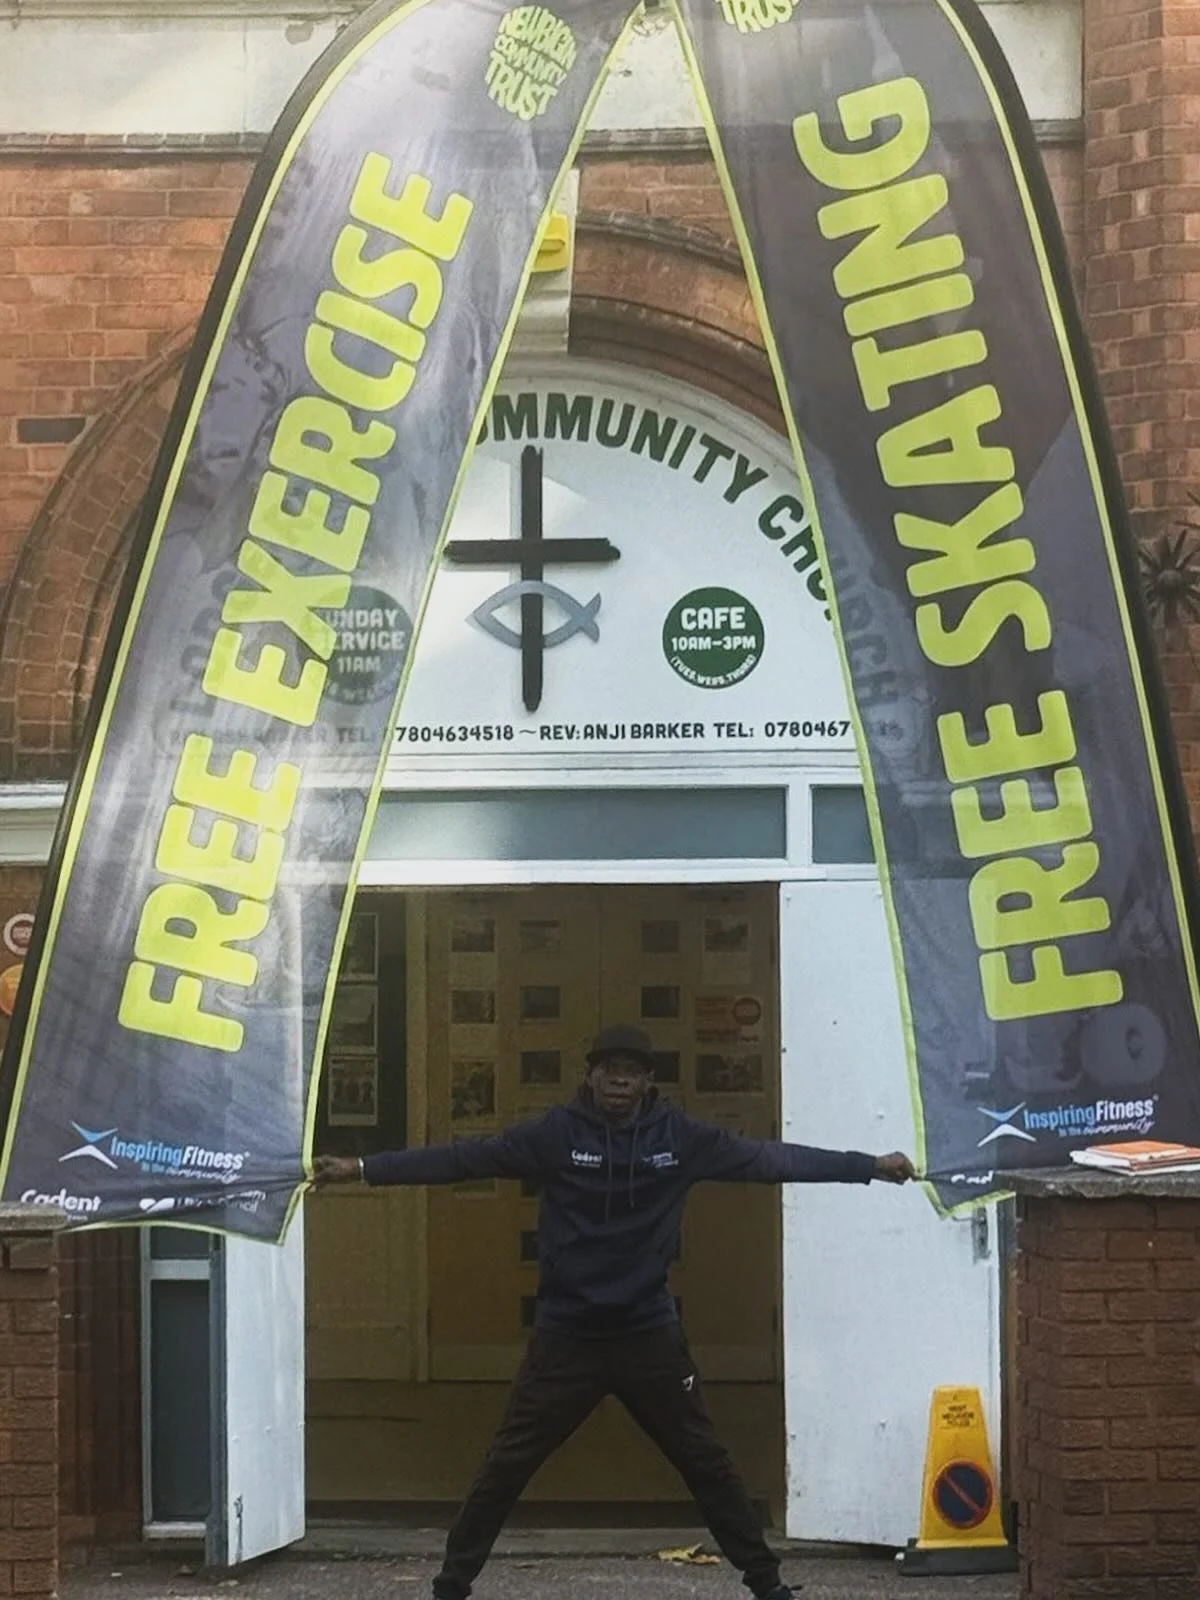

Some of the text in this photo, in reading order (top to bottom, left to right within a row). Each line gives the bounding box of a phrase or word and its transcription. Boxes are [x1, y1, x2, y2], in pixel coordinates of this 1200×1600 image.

[484, 50, 558, 120] TRUST
[494, 34, 568, 87] COMMUNITY
[203, 152, 474, 726] EXERCISE
[793, 76, 1123, 1021] FREE SKATING
[318, 608, 398, 628] UNDAY
[681, 606, 746, 630] CAFE
[338, 656, 380, 673] 11AM
[386, 725, 514, 742] 7804634518
[630, 723, 705, 739] BARKER
[713, 722, 754, 738] TEL:
[764, 721, 851, 737] 0780467
[118, 734, 300, 1053] FREE
